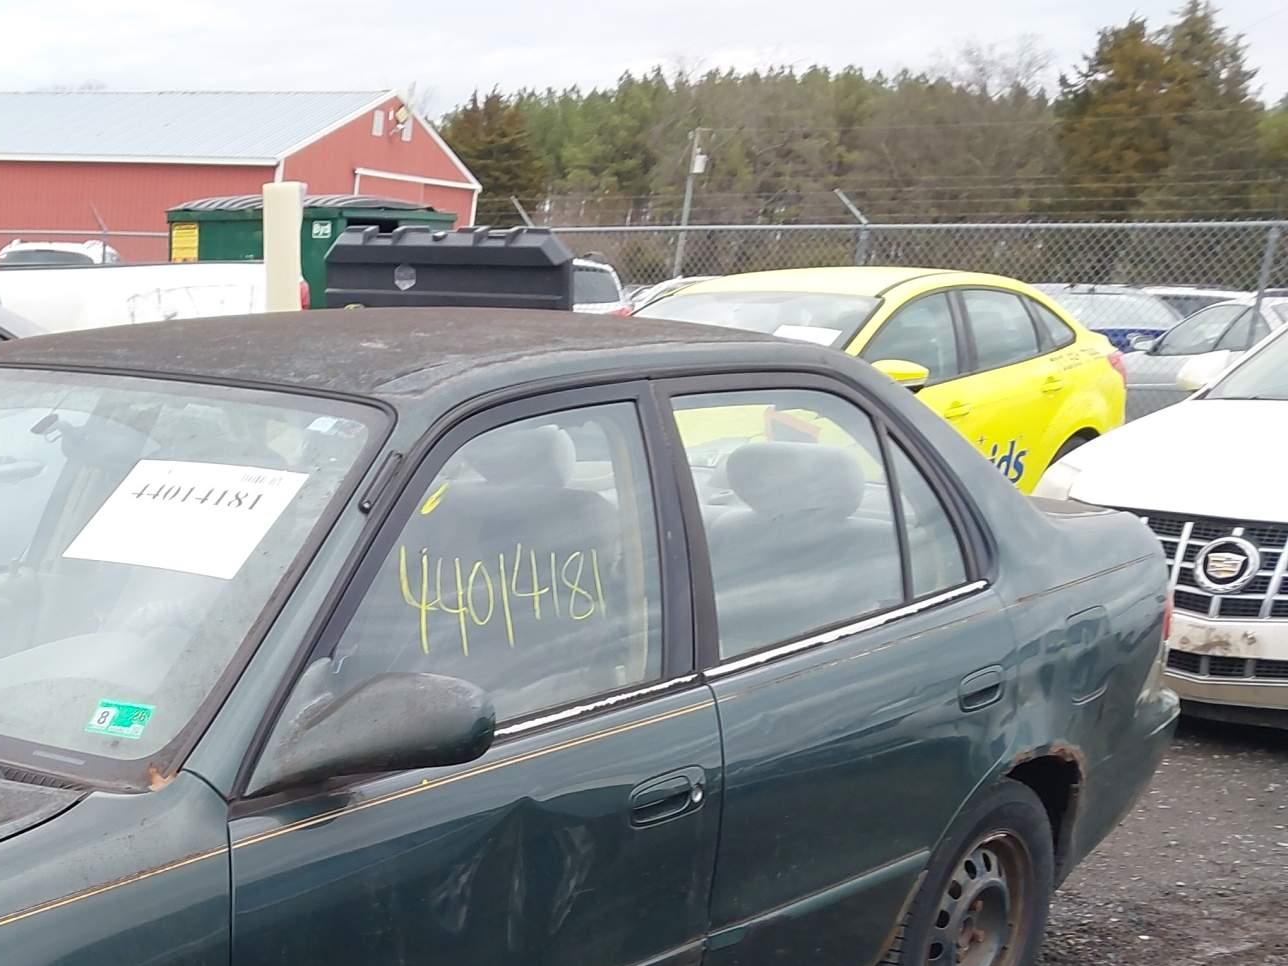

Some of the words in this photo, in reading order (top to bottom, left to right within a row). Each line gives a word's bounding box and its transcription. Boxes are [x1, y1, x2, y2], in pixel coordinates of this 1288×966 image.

[131, 482, 265, 511] 44014181
[398, 542, 606, 657] 44014181
[96, 710, 110, 725] 8
